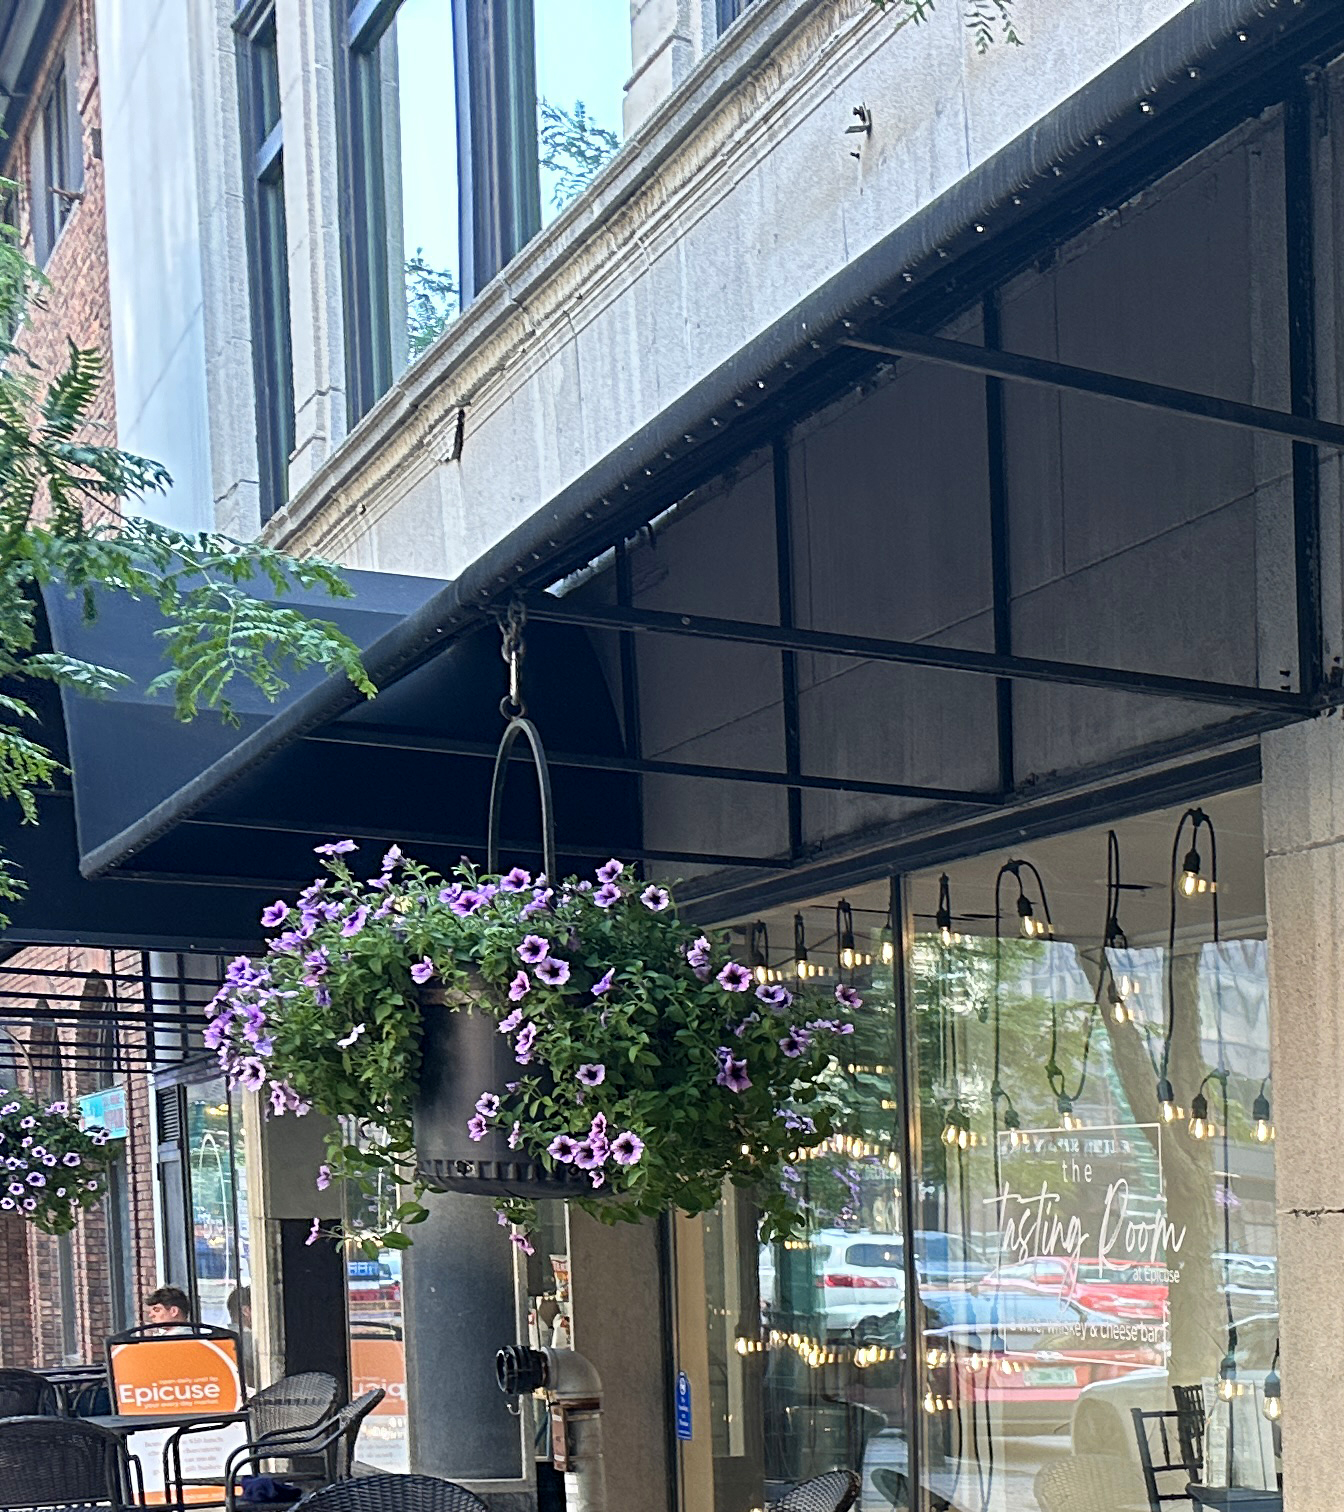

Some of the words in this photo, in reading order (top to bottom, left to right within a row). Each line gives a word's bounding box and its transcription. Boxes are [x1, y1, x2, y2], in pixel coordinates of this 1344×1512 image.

[1061, 1158, 1093, 1183] the
[1098, 1178, 1187, 1279] Room
[118, 1382, 221, 1408] Epicuse
